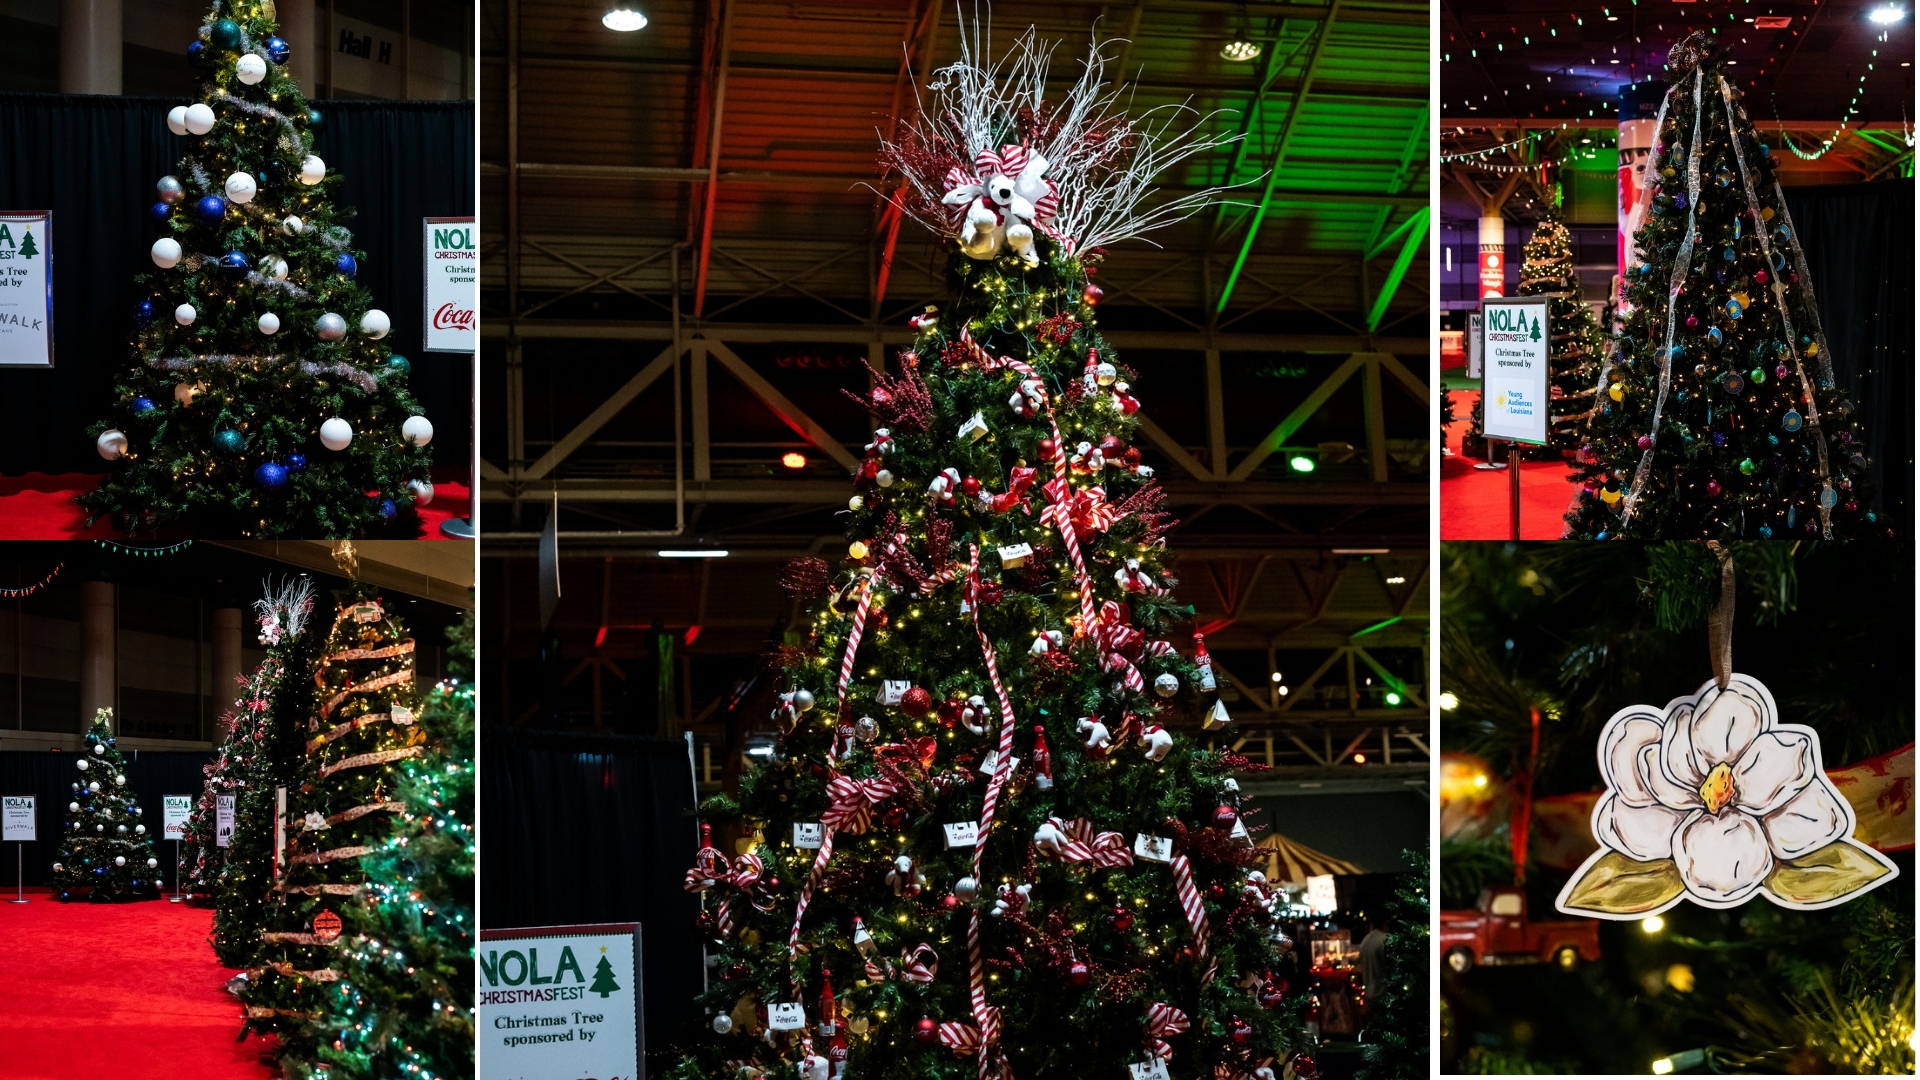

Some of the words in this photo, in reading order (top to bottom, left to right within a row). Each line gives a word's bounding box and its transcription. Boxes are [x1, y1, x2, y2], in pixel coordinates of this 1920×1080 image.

[339, 29, 372, 60] Hall
[378, 41, 392, 65] H
[7, 267, 28, 276] Tree
[11, 278, 22, 288] by
[1488, 308, 1529, 332] NOLA
[1488, 333, 1529, 343] CHRISTMASFEST
[1495, 348, 1522, 358] Christmas
[1522, 349, 1535, 358] Tree
[1524, 359, 1532, 369] by
[1507, 389, 1523, 400] Young
[1507, 399, 1533, 407] Audiences
[1510, 407, 1533, 416] Louisiana
[120, 718, 134, 732] To
[138, 720, 177, 736] Lobby
[5, 798, 26, 806] NOLA
[166, 798, 183, 806] NOLA
[480, 945, 586, 986] NOLA
[494, 1014, 568, 1029] Christmas
[572, 1009, 605, 1025] Tree
[503, 1028, 574, 1048] sponsored
[579, 1027, 597, 1043] by
[830, 1045, 847, 1059] Coca
